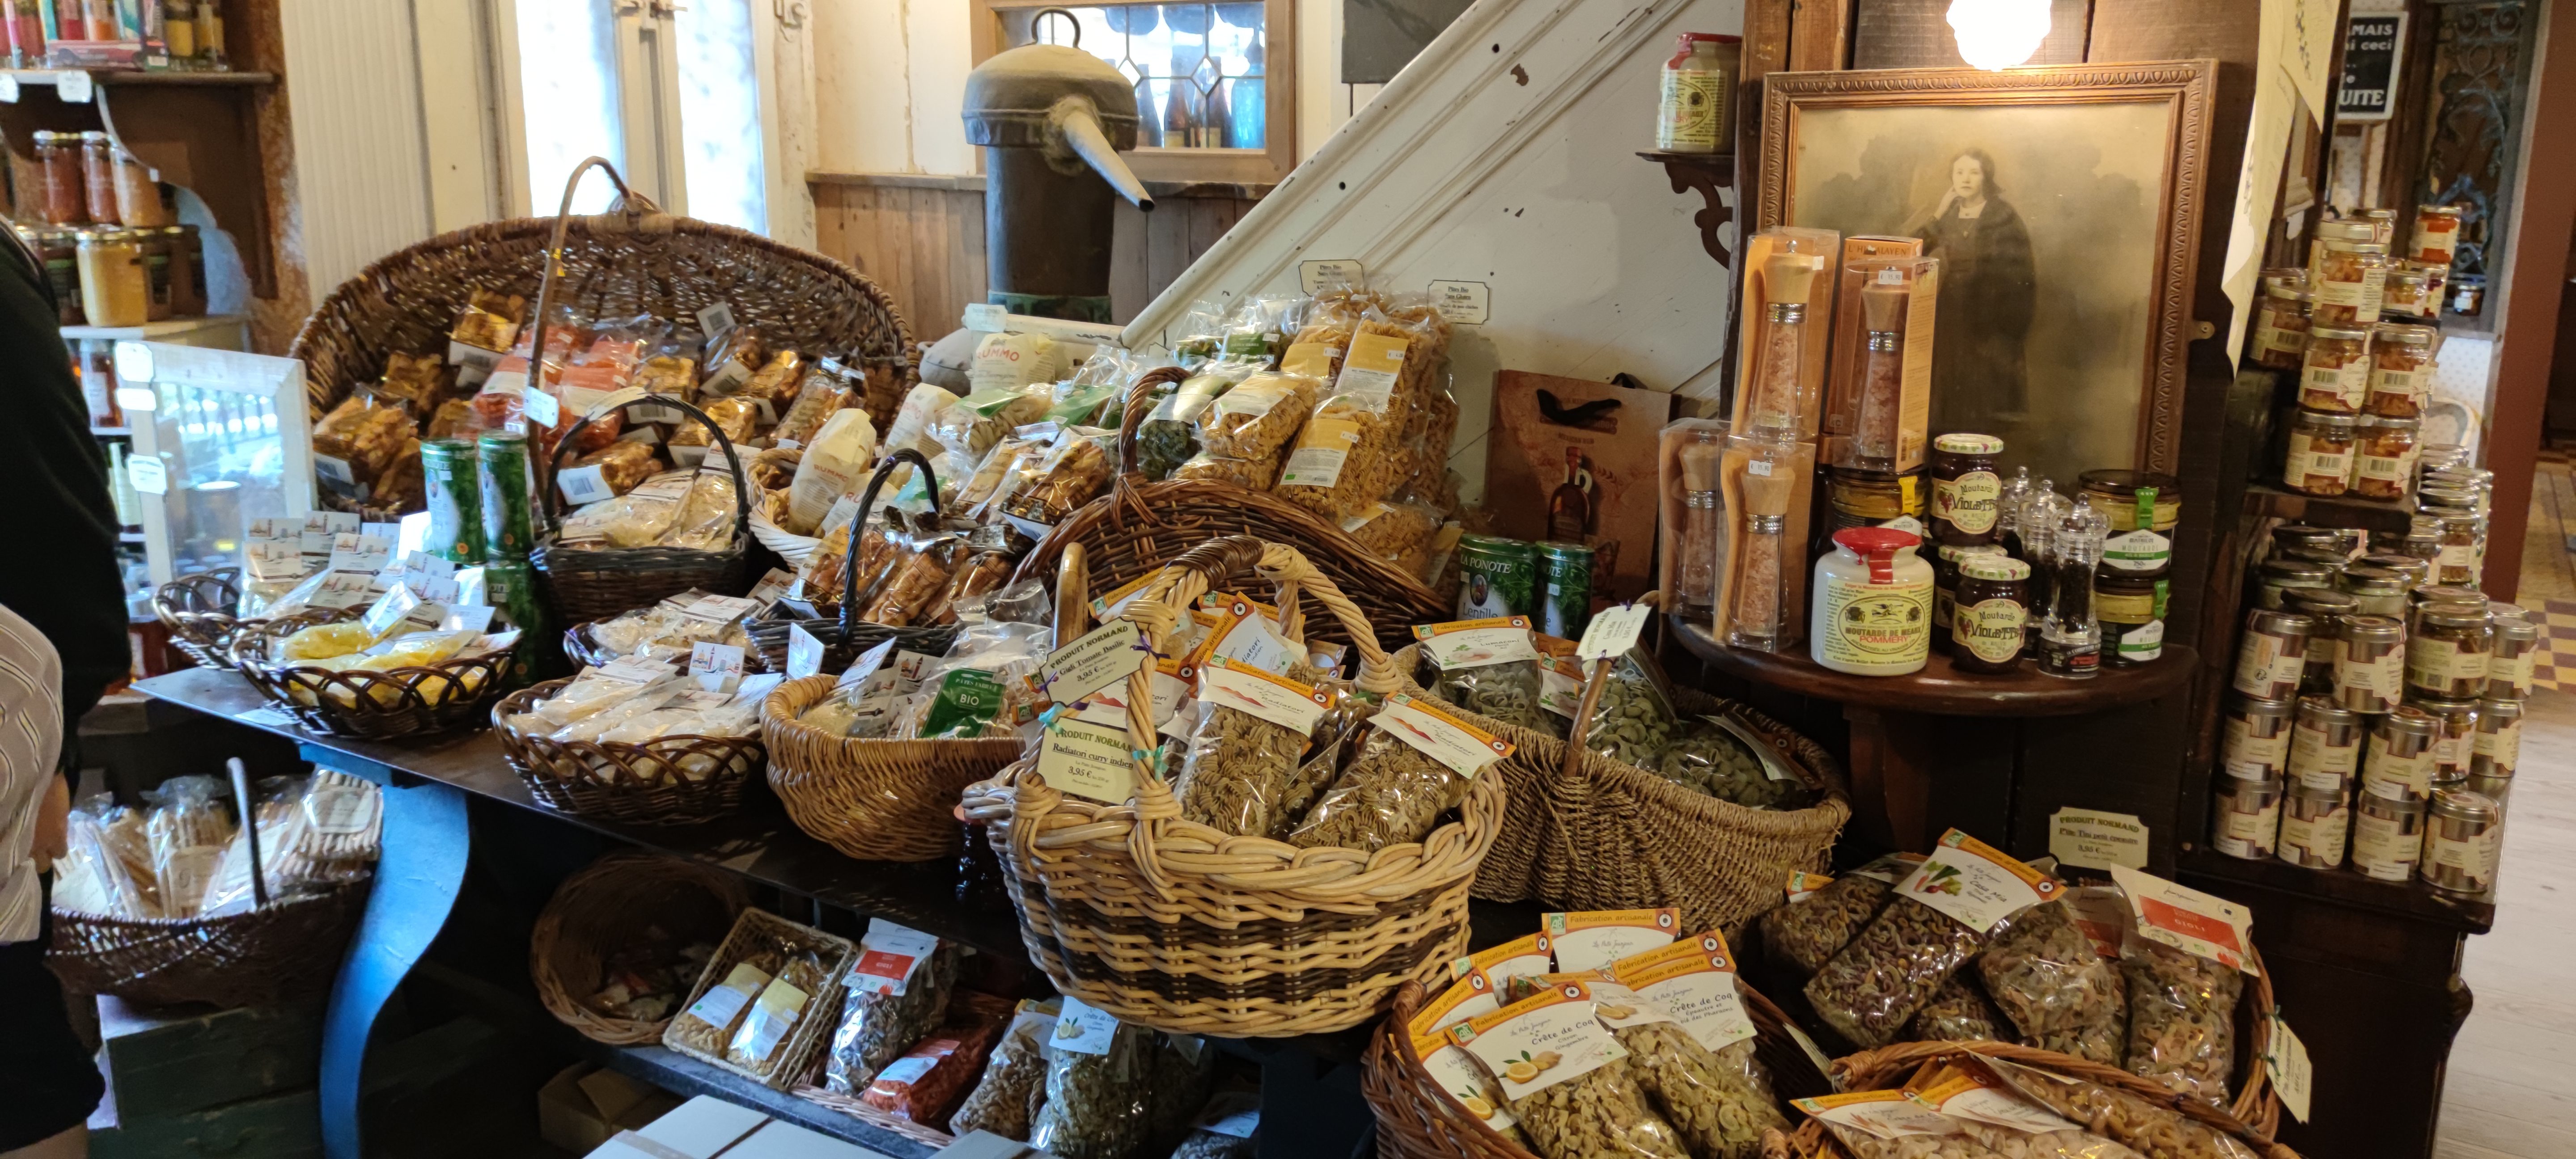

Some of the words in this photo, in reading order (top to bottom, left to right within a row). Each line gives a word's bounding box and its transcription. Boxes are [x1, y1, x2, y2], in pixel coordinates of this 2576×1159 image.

[2349, 24, 2393, 36] MAIS
[2361, 39, 2392, 51] ceci
[2339, 90, 2384, 106] UITE
[813, 464, 849, 482] RUMMO
[1460, 554, 1468, 565] LA
[1470, 556, 1512, 574] PONOTE
[1209, 615, 1232, 647] artisanale
[1436, 622, 1473, 631] Fabrication
[1845, 627, 1887, 636] MOUTARDE
[1901, 626, 1921, 636] MEAUX
[1050, 643, 1085, 669] PRODUIT
[1086, 626, 1128, 648] NORMAND
[1480, 639, 1520, 647] Lumaconi
[1860, 635, 1909, 643] POMMERY
[1059, 661, 1076, 676] Gigli
[1076, 650, 1102, 667] Tomate
[1102, 639, 1125, 653] Basilic
[1241, 637, 1261, 663] diatori
[1076, 671, 1093, 682] 3,95
[1232, 661, 1271, 679] Fabrication
[1274, 677, 1309, 693] artisanale
[960, 694, 979, 706] BIO
[1261, 696, 1305, 713] Radiatori
[1414, 701, 1453, 723] Fabrication
[1454, 720, 1490, 740] artisanale
[1094, 735, 1133, 753] NORMAN
[1435, 733, 1477, 757] Radiatori
[1053, 743, 1087, 758] Radiatori
[1088, 753, 1109, 763] curry
[1110, 756, 1134, 769] indien
[1068, 766, 1085, 776] 3,95
[2097, 819, 2140, 833] NORMAND
[1570, 913, 1613, 923] Fabrication
[1615, 912, 1653, 921] artisanale
[1474, 948, 1507, 965] Fabrication
[1508, 939, 1534, 954] artisanale
[1618, 953, 1660, 972] Fabrication
[1661, 940, 1698, 958] artisanale
[1627, 970, 1665, 987] abrication
[1667, 958, 1706, 975] artisanale
[1412, 1007, 1443, 1033] Fabrication
[1442, 982, 1469, 1007] artisanale
[1475, 1007, 1519, 1027] Fabrication
[1521, 991, 1558, 1010] artisanale
[1669, 1002, 1696, 1014] Crête
[1700, 997, 1711, 1007] de
[1714, 992, 1733, 1002] Coq
[1704, 1006, 1733, 1019] Pharaons
[1531, 1032, 1559, 1045] Crête
[1561, 1026, 1573, 1034] de
[1576, 1019, 1595, 1028] Coq
[1558, 1033, 1578, 1043] Citron
[1555, 1035, 1589, 1051] Gingembre
